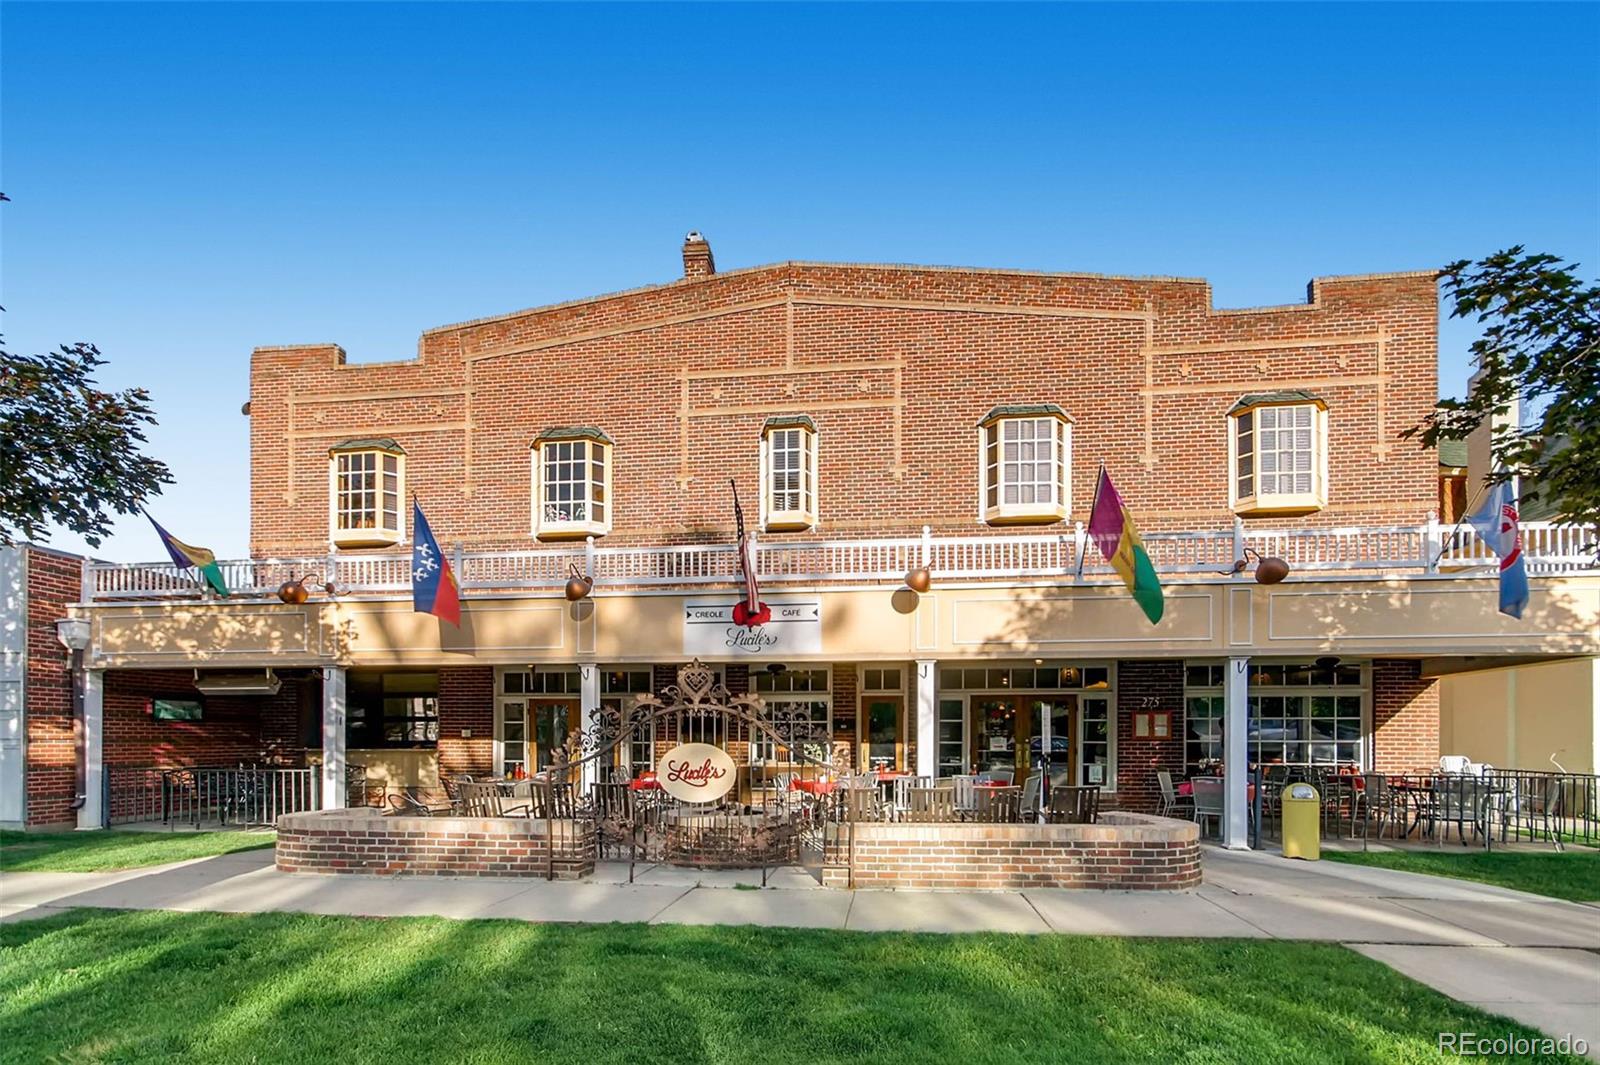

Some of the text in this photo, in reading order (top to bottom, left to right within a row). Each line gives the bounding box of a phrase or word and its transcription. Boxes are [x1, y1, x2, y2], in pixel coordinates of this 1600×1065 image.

[695, 610, 724, 618] CREOLE
[725, 627, 778, 653] Lucile's
[1141, 696, 1160, 709] 275
[667, 758, 727, 787] Lucile's
